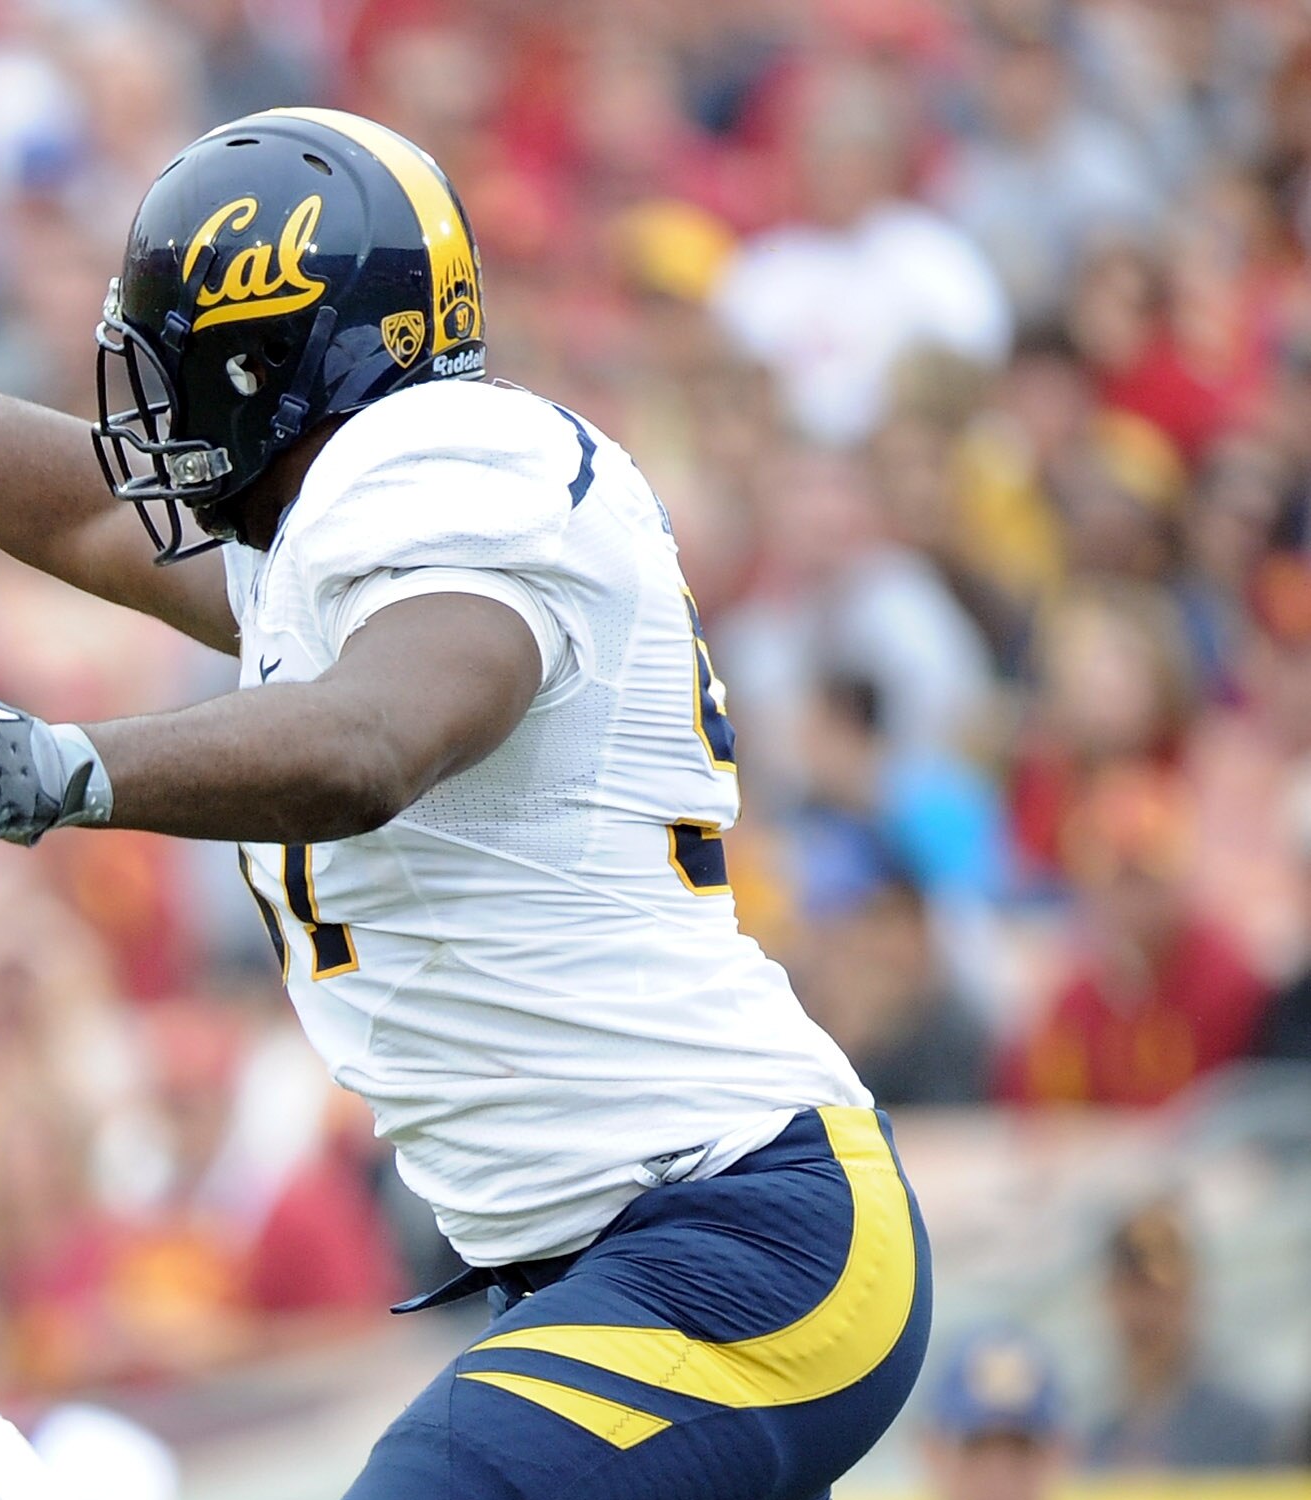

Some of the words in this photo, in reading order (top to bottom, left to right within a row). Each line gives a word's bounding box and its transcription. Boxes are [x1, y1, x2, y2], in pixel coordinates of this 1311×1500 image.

[183, 195, 325, 332] Cal
[385, 314, 421, 348] PAC
[395, 336, 417, 359] 10
